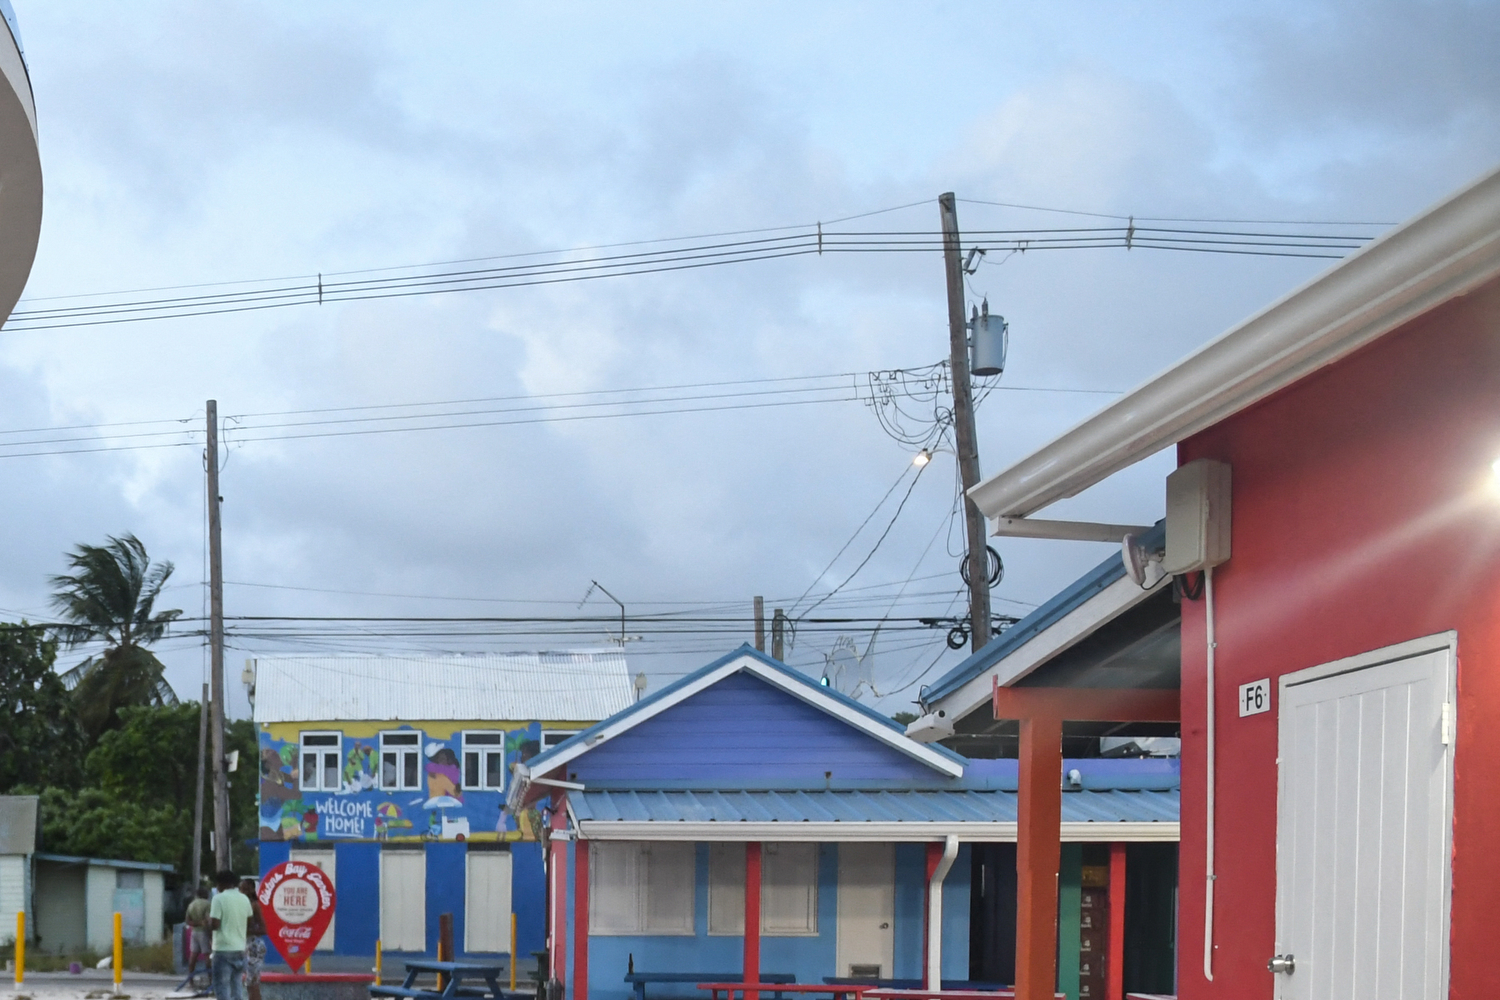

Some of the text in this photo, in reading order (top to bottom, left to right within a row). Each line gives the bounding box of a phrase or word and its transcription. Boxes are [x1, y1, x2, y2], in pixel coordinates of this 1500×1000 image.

[1246, 685, 1263, 711] F6
[315, 797, 373, 818] WELCOME
[325, 815, 364, 834] HOME!
[285, 863, 307, 878] Bay
[306, 873, 332, 910] Garden
[283, 895, 307, 907] HERE
